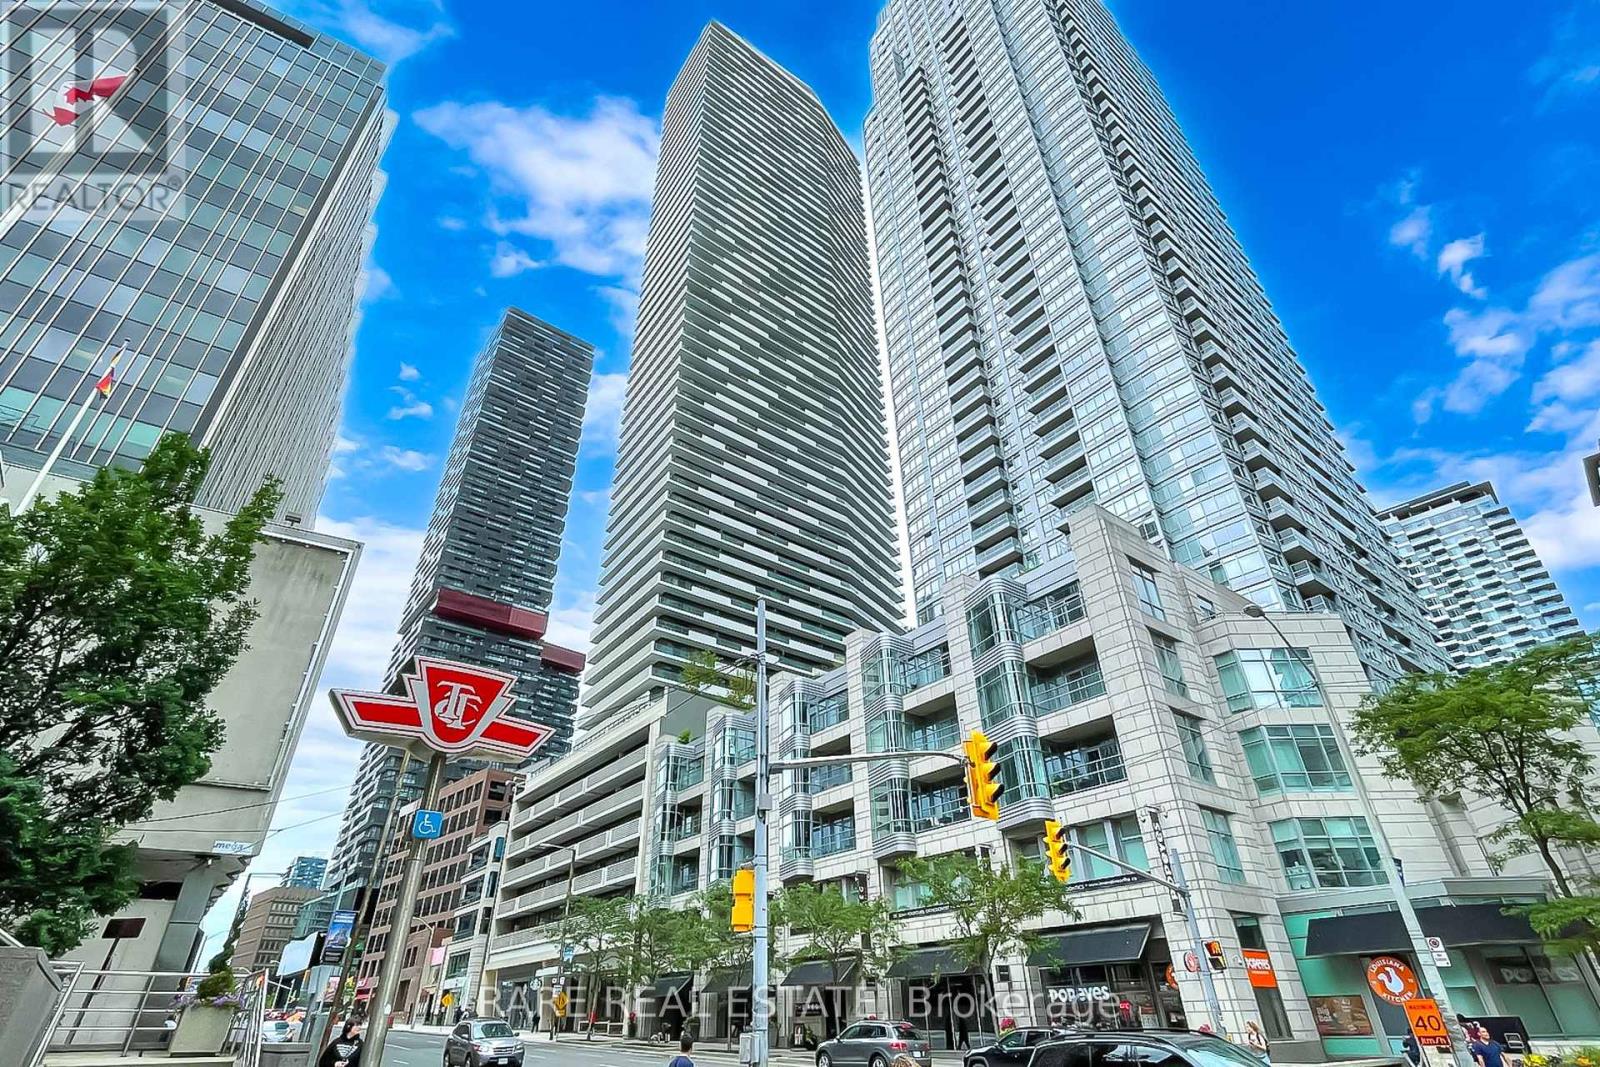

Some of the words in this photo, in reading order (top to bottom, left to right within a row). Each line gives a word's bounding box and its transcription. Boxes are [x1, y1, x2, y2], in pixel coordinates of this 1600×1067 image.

[1370, 958, 1405, 973] LOUISIANA
[1415, 1015, 1441, 1032] 40
[1420, 1036, 1447, 1045] km/h
